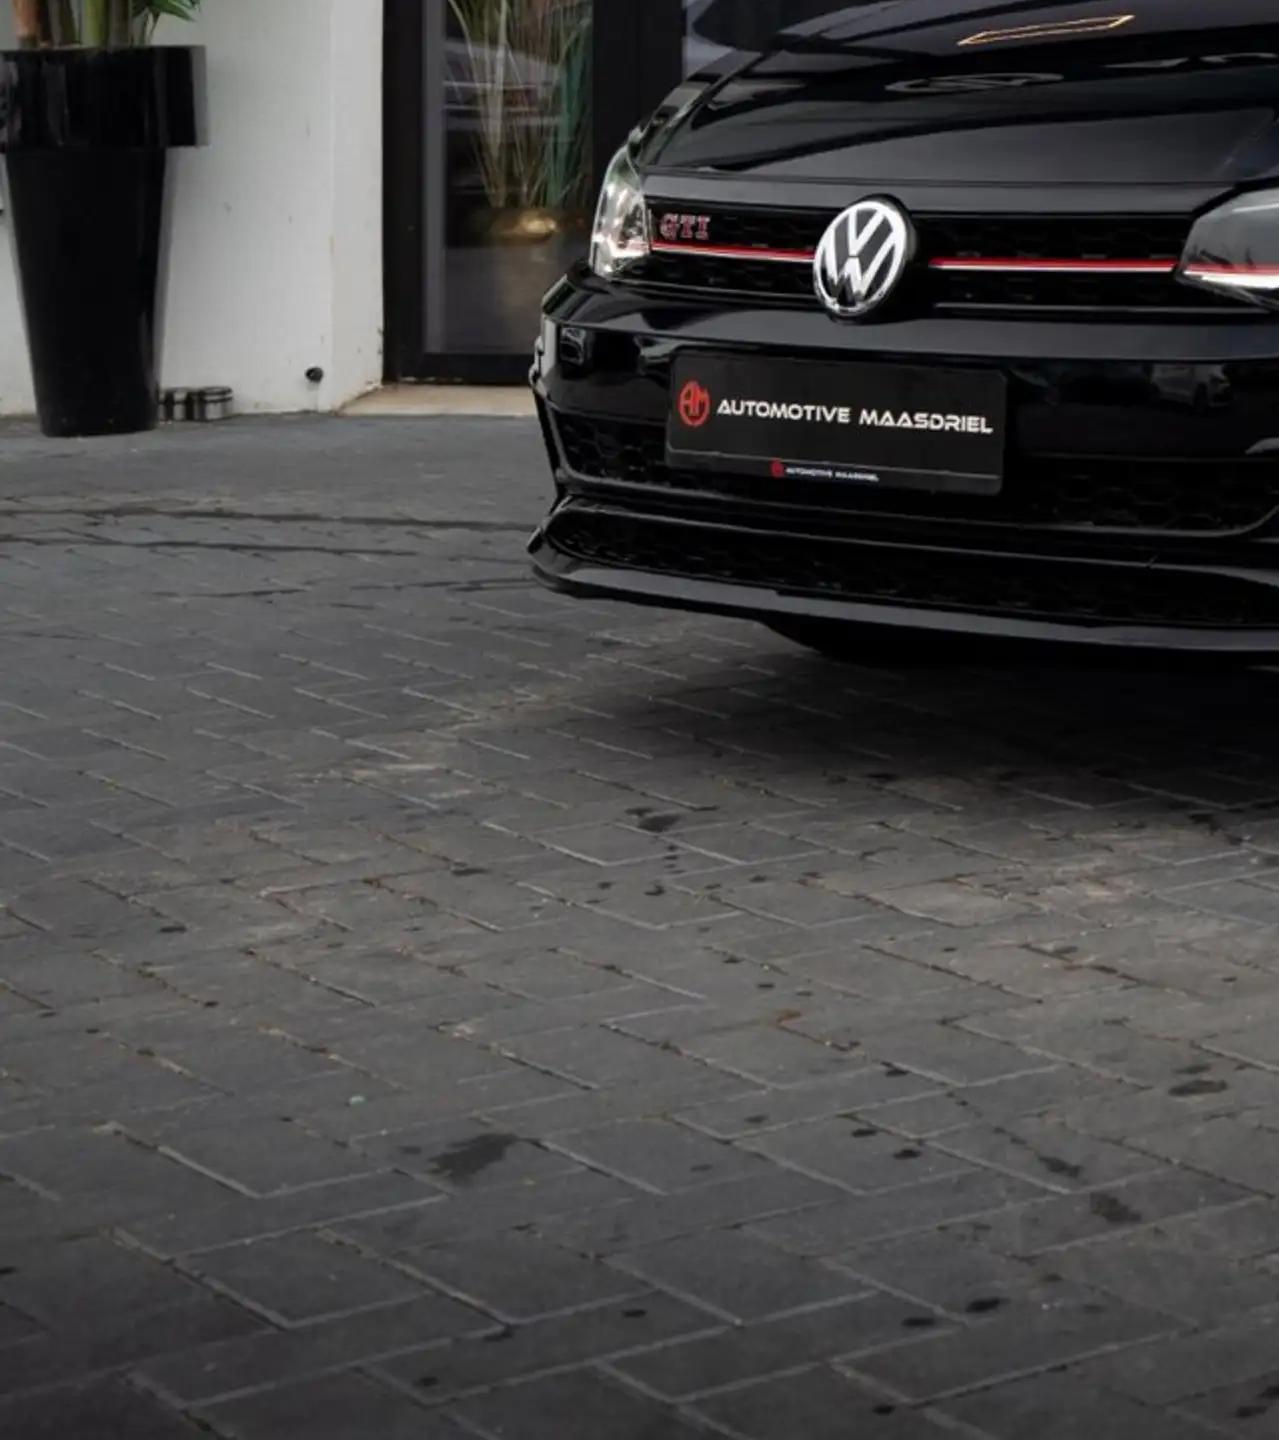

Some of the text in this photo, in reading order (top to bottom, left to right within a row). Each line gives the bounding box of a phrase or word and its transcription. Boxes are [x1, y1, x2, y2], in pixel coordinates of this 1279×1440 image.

[659, 213, 711, 241] GTI
[716, 398, 851, 424] AUTOMOTIVE
[858, 409, 994, 434] MAASDRIEL
